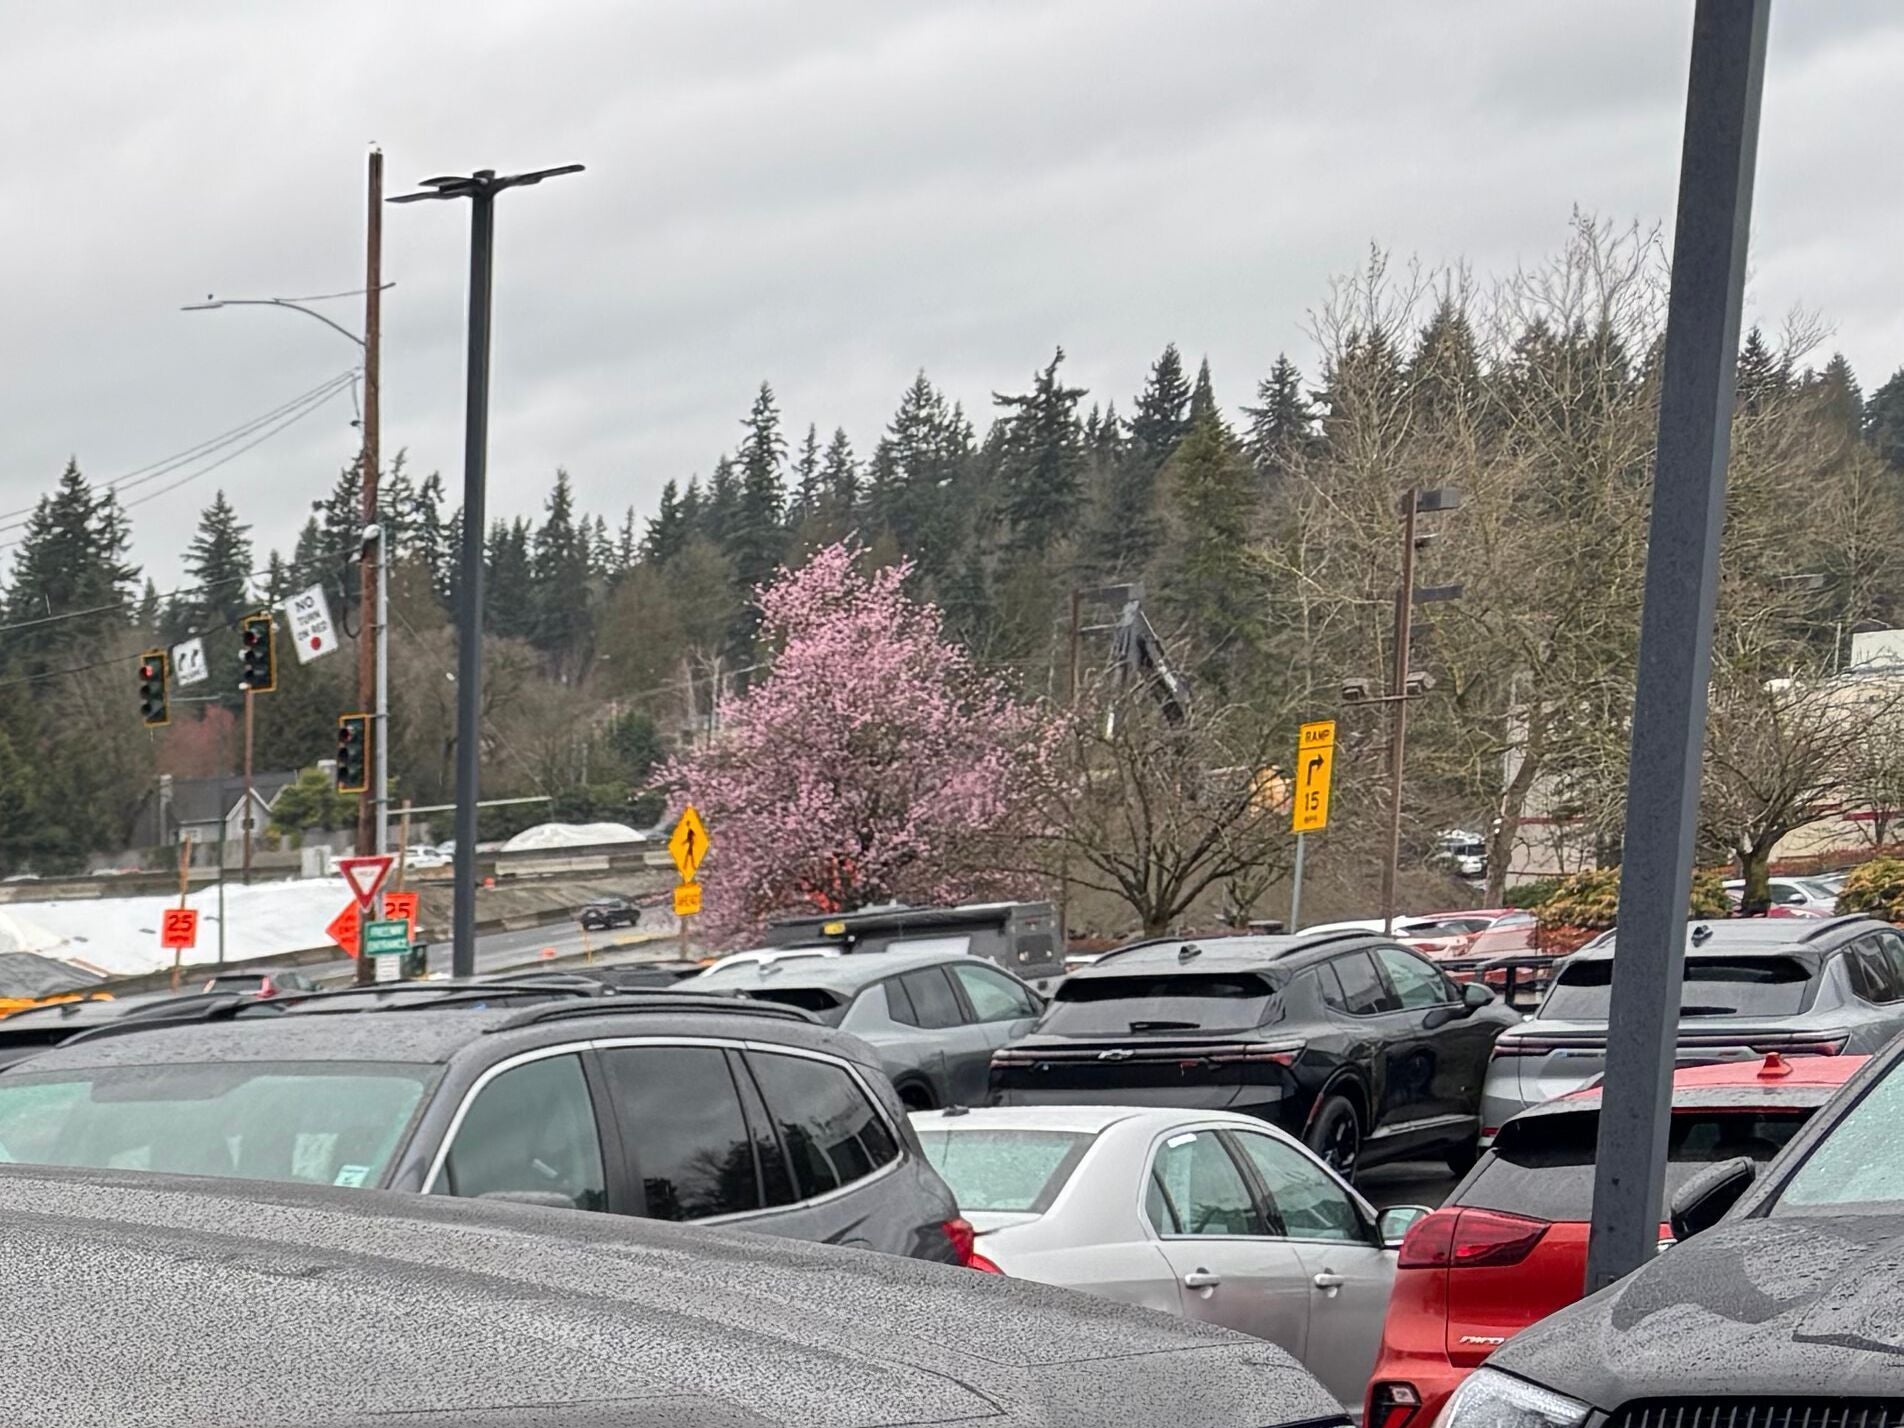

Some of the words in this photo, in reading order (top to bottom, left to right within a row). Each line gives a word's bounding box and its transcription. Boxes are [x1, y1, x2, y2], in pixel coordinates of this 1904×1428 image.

[294, 595, 315, 613] NO
[1305, 729, 1330, 742] RAMP
[1305, 790, 1320, 812] 15
[385, 902, 410, 919] 25
[168, 914, 193, 932] 25
